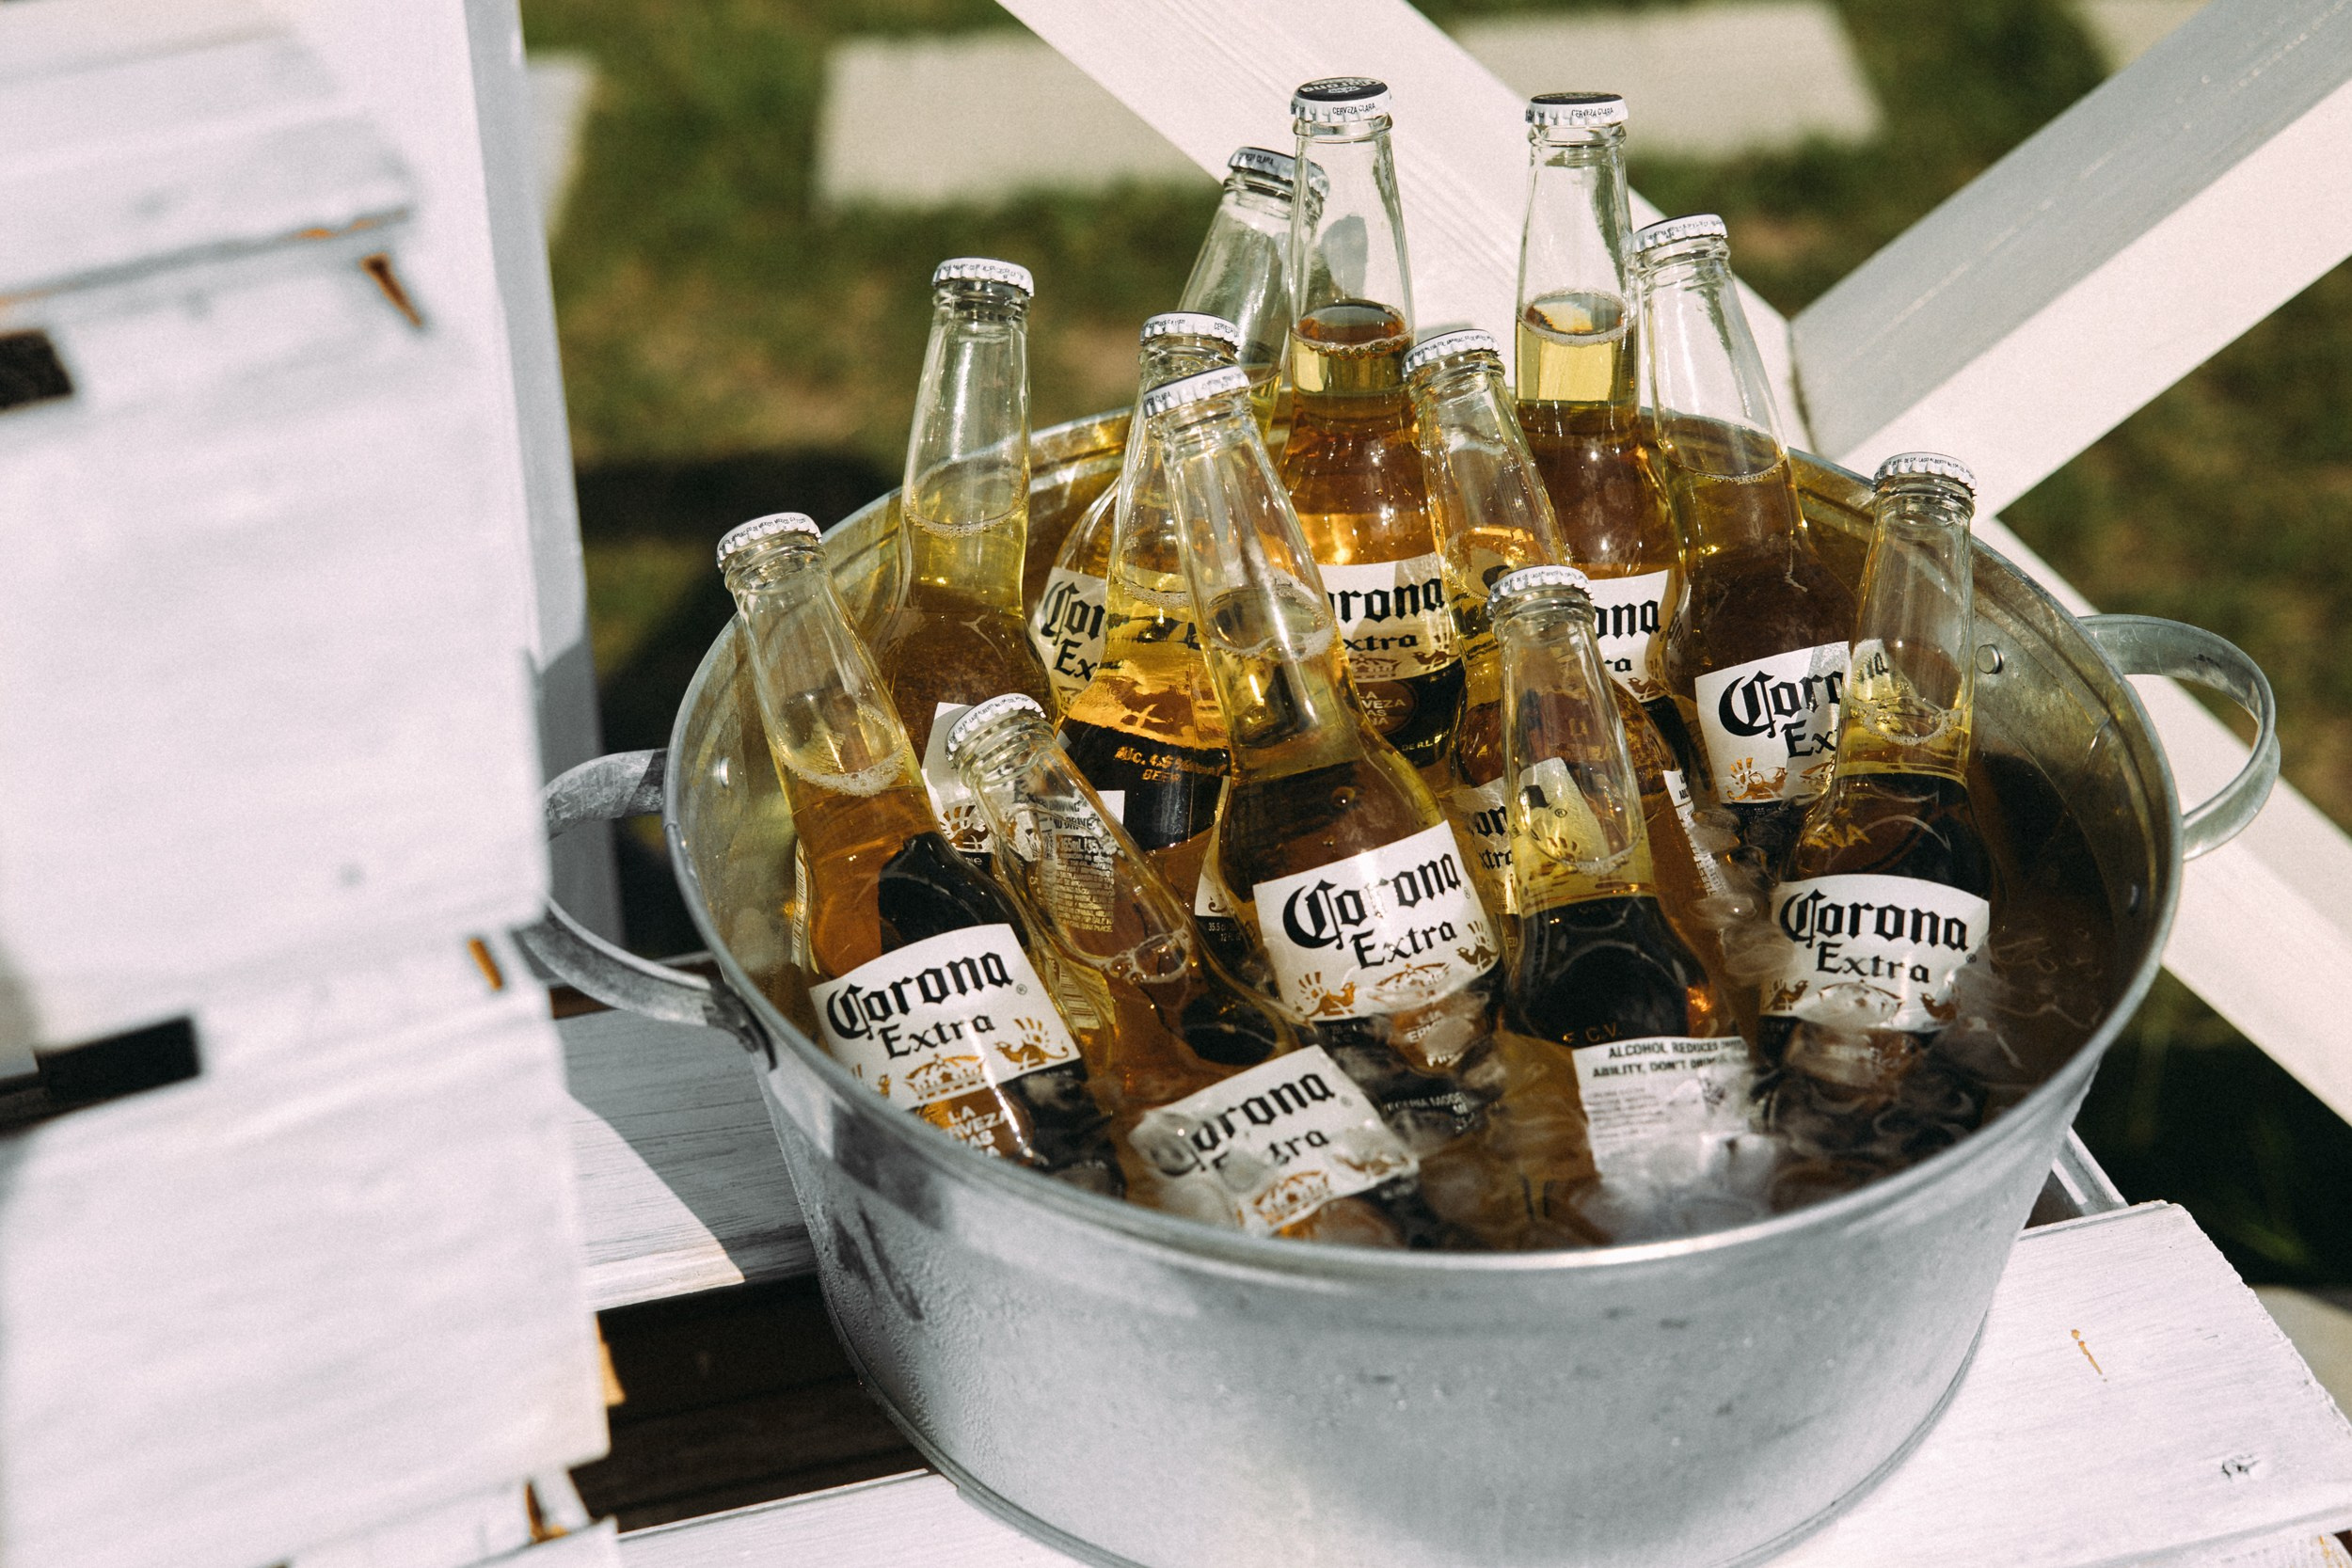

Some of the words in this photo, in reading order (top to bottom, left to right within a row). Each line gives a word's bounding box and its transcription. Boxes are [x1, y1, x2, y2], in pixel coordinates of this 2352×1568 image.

[1343, 634, 1420, 652] xtra
[1779, 889, 1969, 952] Corona
[1348, 921, 1457, 969] Extra
[1816, 941, 1931, 984] Extra
[826, 951, 1013, 1041] Corona
[878, 1012, 995, 1059] Extra
[1609, 1041, 1666, 1059] ALCOHOL
